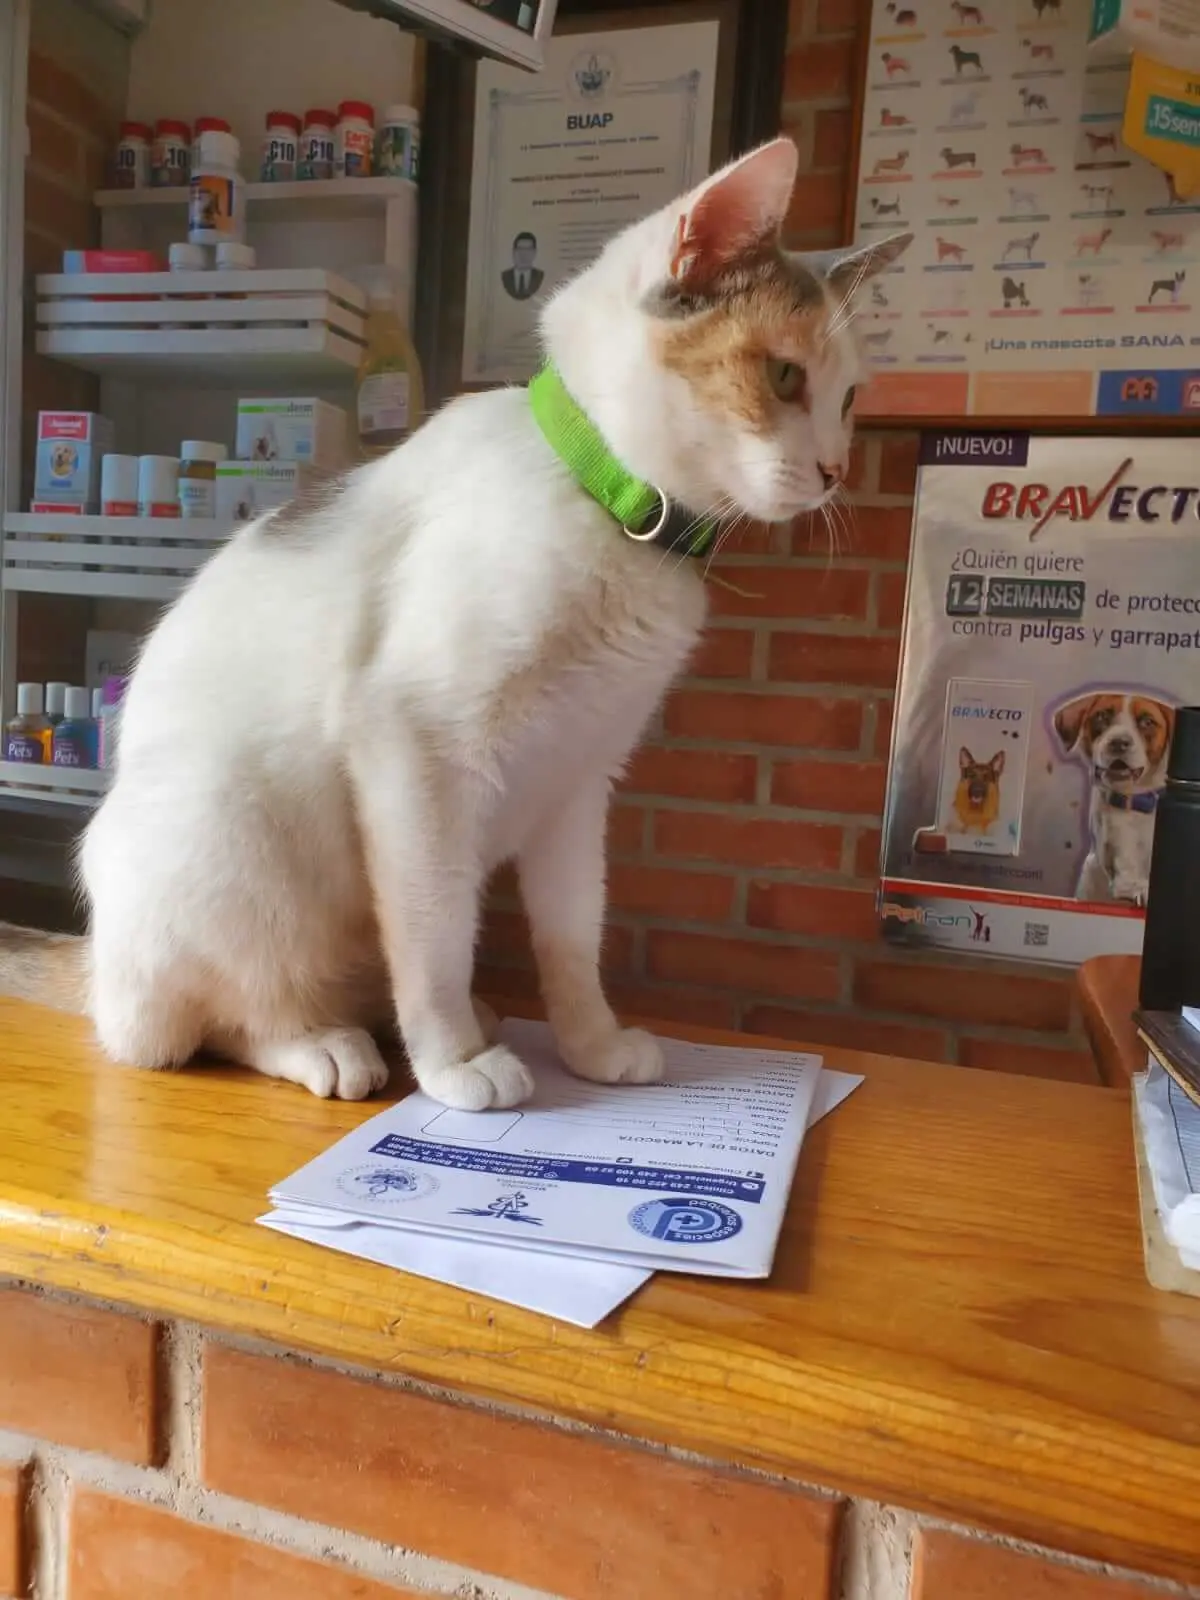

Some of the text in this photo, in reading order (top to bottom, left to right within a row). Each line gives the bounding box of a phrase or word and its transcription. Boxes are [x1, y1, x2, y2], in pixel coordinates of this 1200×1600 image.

[566, 113, 613, 130] BUAP
[1031, 337, 1116, 349] mascota
[1120, 334, 1185, 348] SANA
[936, 436, 1013, 457] ¡NUEVO!
[982, 458, 1200, 542] BRAVECT
[951, 548, 1084, 576] ¿Quién quiere
[951, 581, 980, 606] 12
[990, 583, 1082, 610] SEMANAS
[1096, 590, 1121, 609] de
[952, 619, 1012, 637] contra
[1020, 619, 1085, 645] pulgas
[1093, 631, 1104, 647] y
[952, 706, 1022, 720] BRAVECTO
[617, 1135, 682, 1144] MASCOTA
[727, 1145, 775, 1157] DATOS
